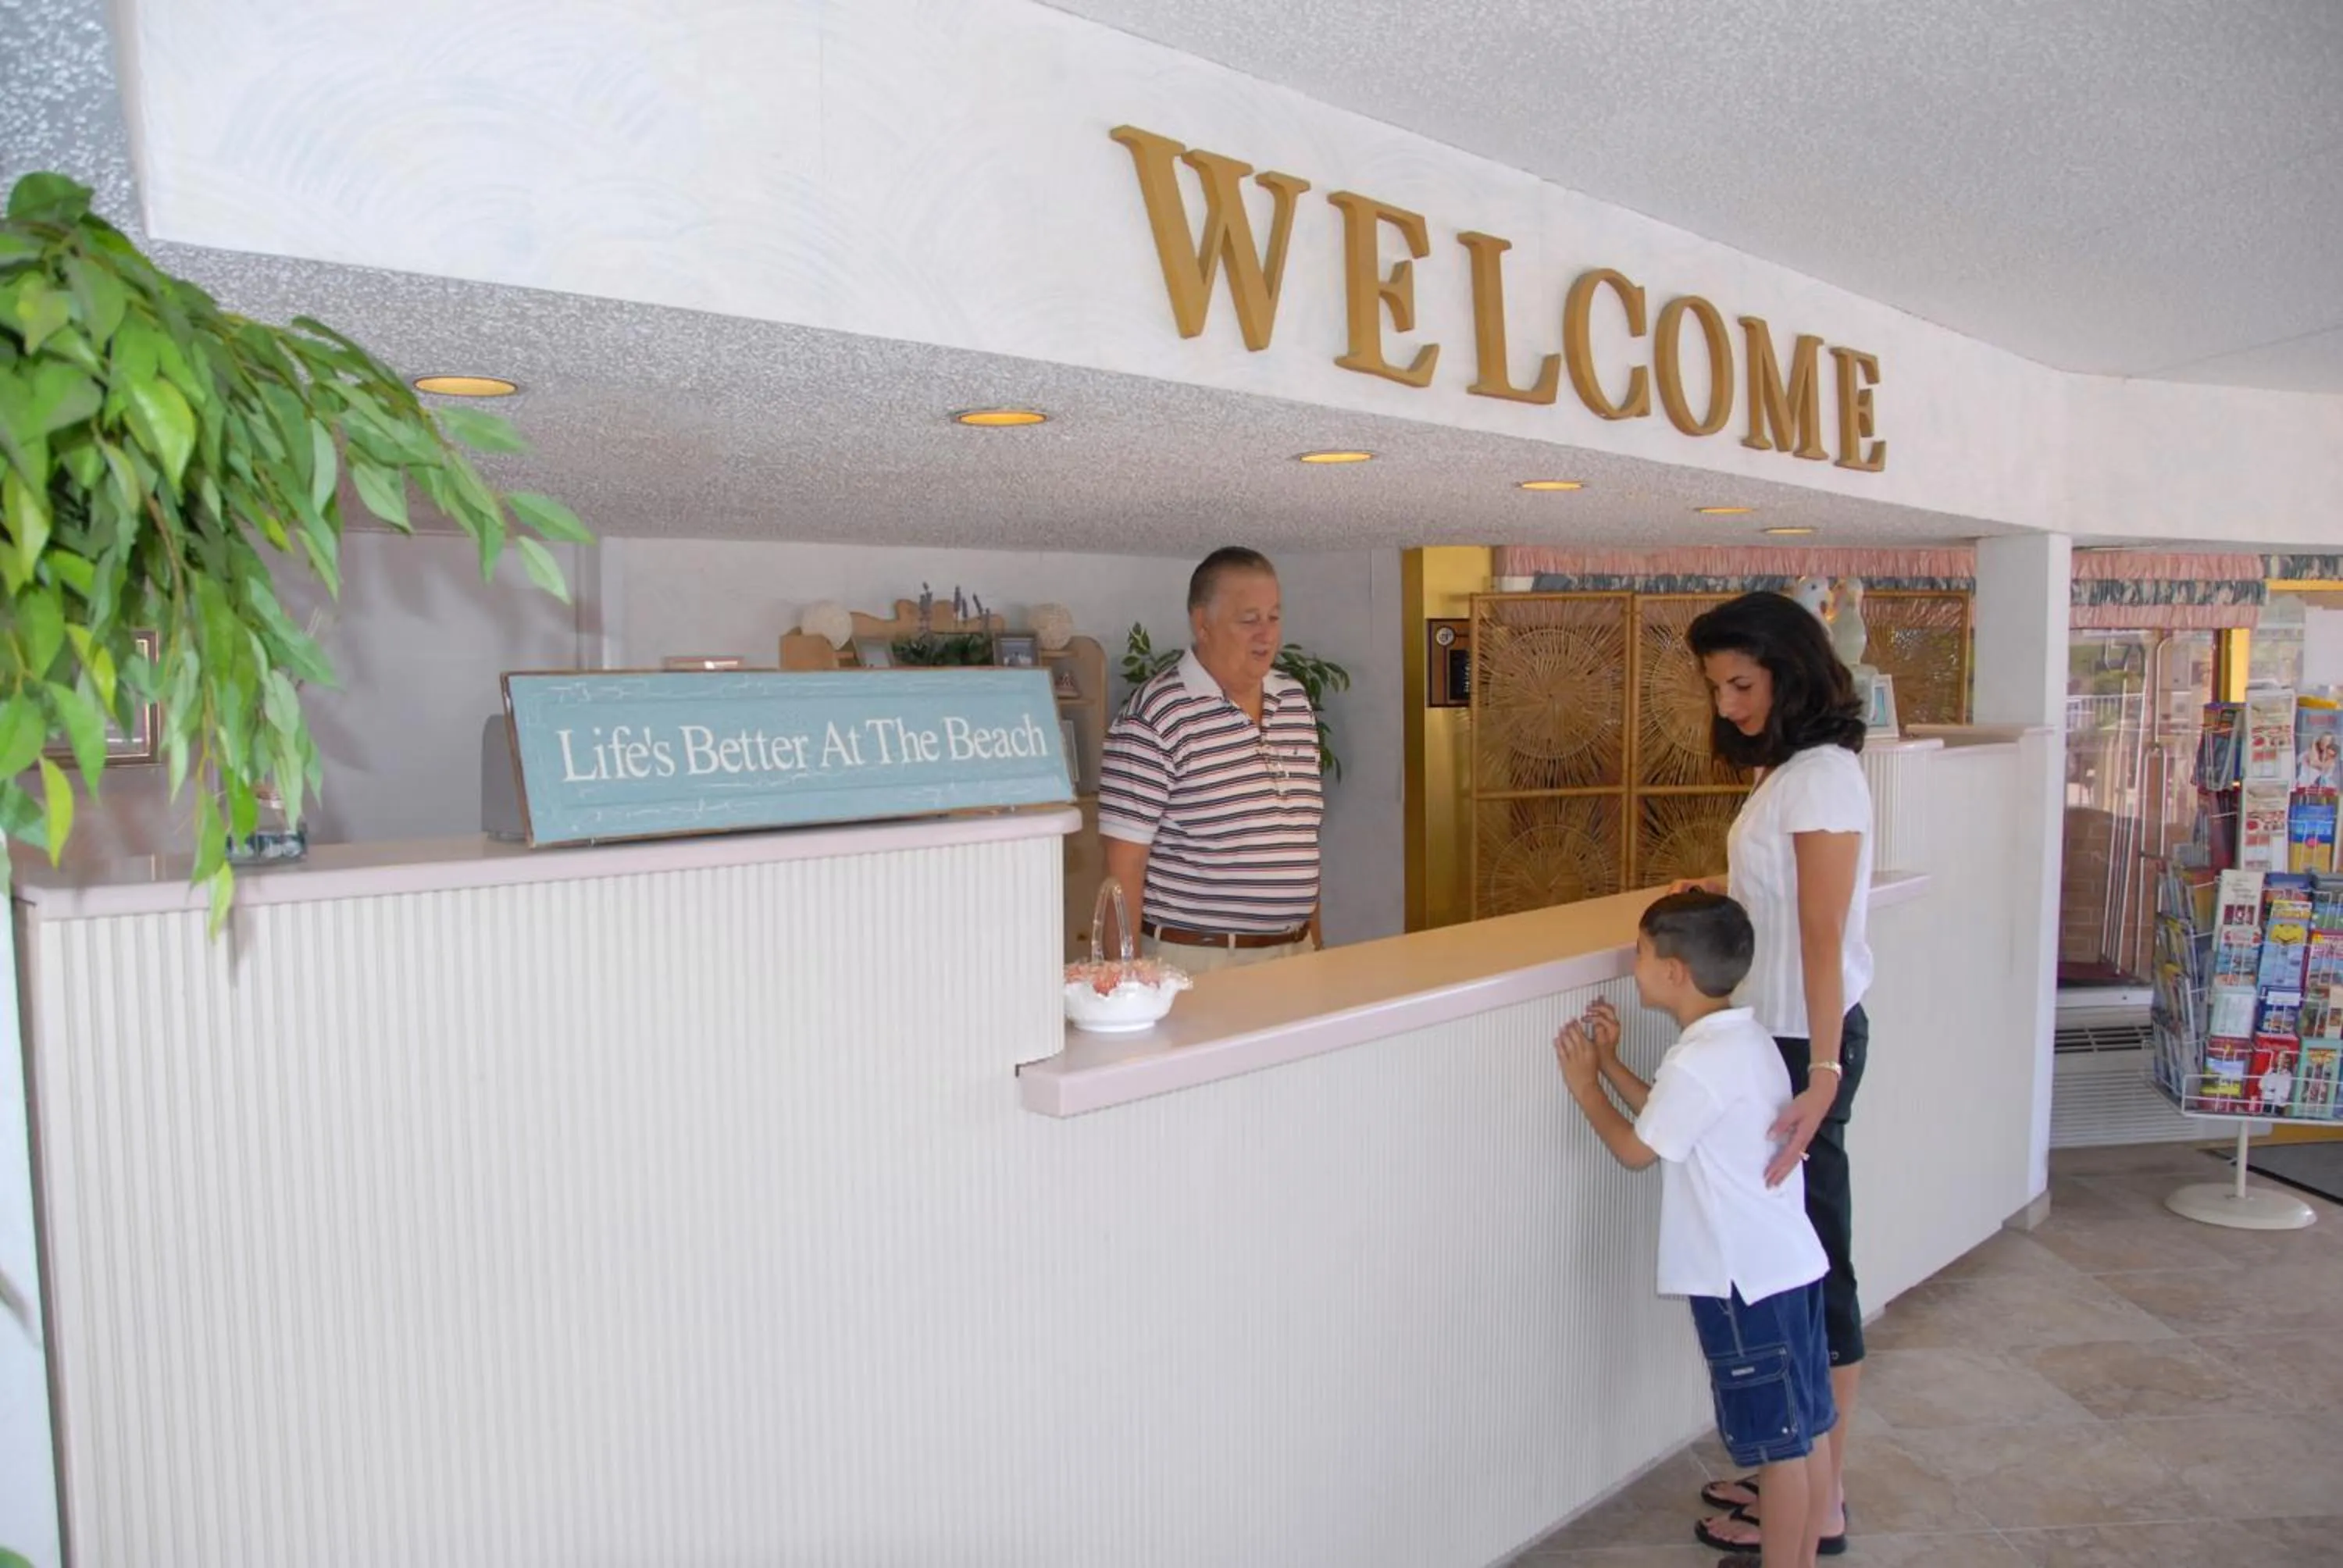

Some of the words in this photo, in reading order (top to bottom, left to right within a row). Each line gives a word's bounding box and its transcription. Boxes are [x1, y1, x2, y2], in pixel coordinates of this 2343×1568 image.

[1110, 125, 1885, 472] WELCOME
[555, 726, 675, 782] Life's
[679, 725, 808, 775] Better
[821, 722, 862, 767] At
[866, 719, 938, 765] The
[943, 714, 1049, 760] Beach
